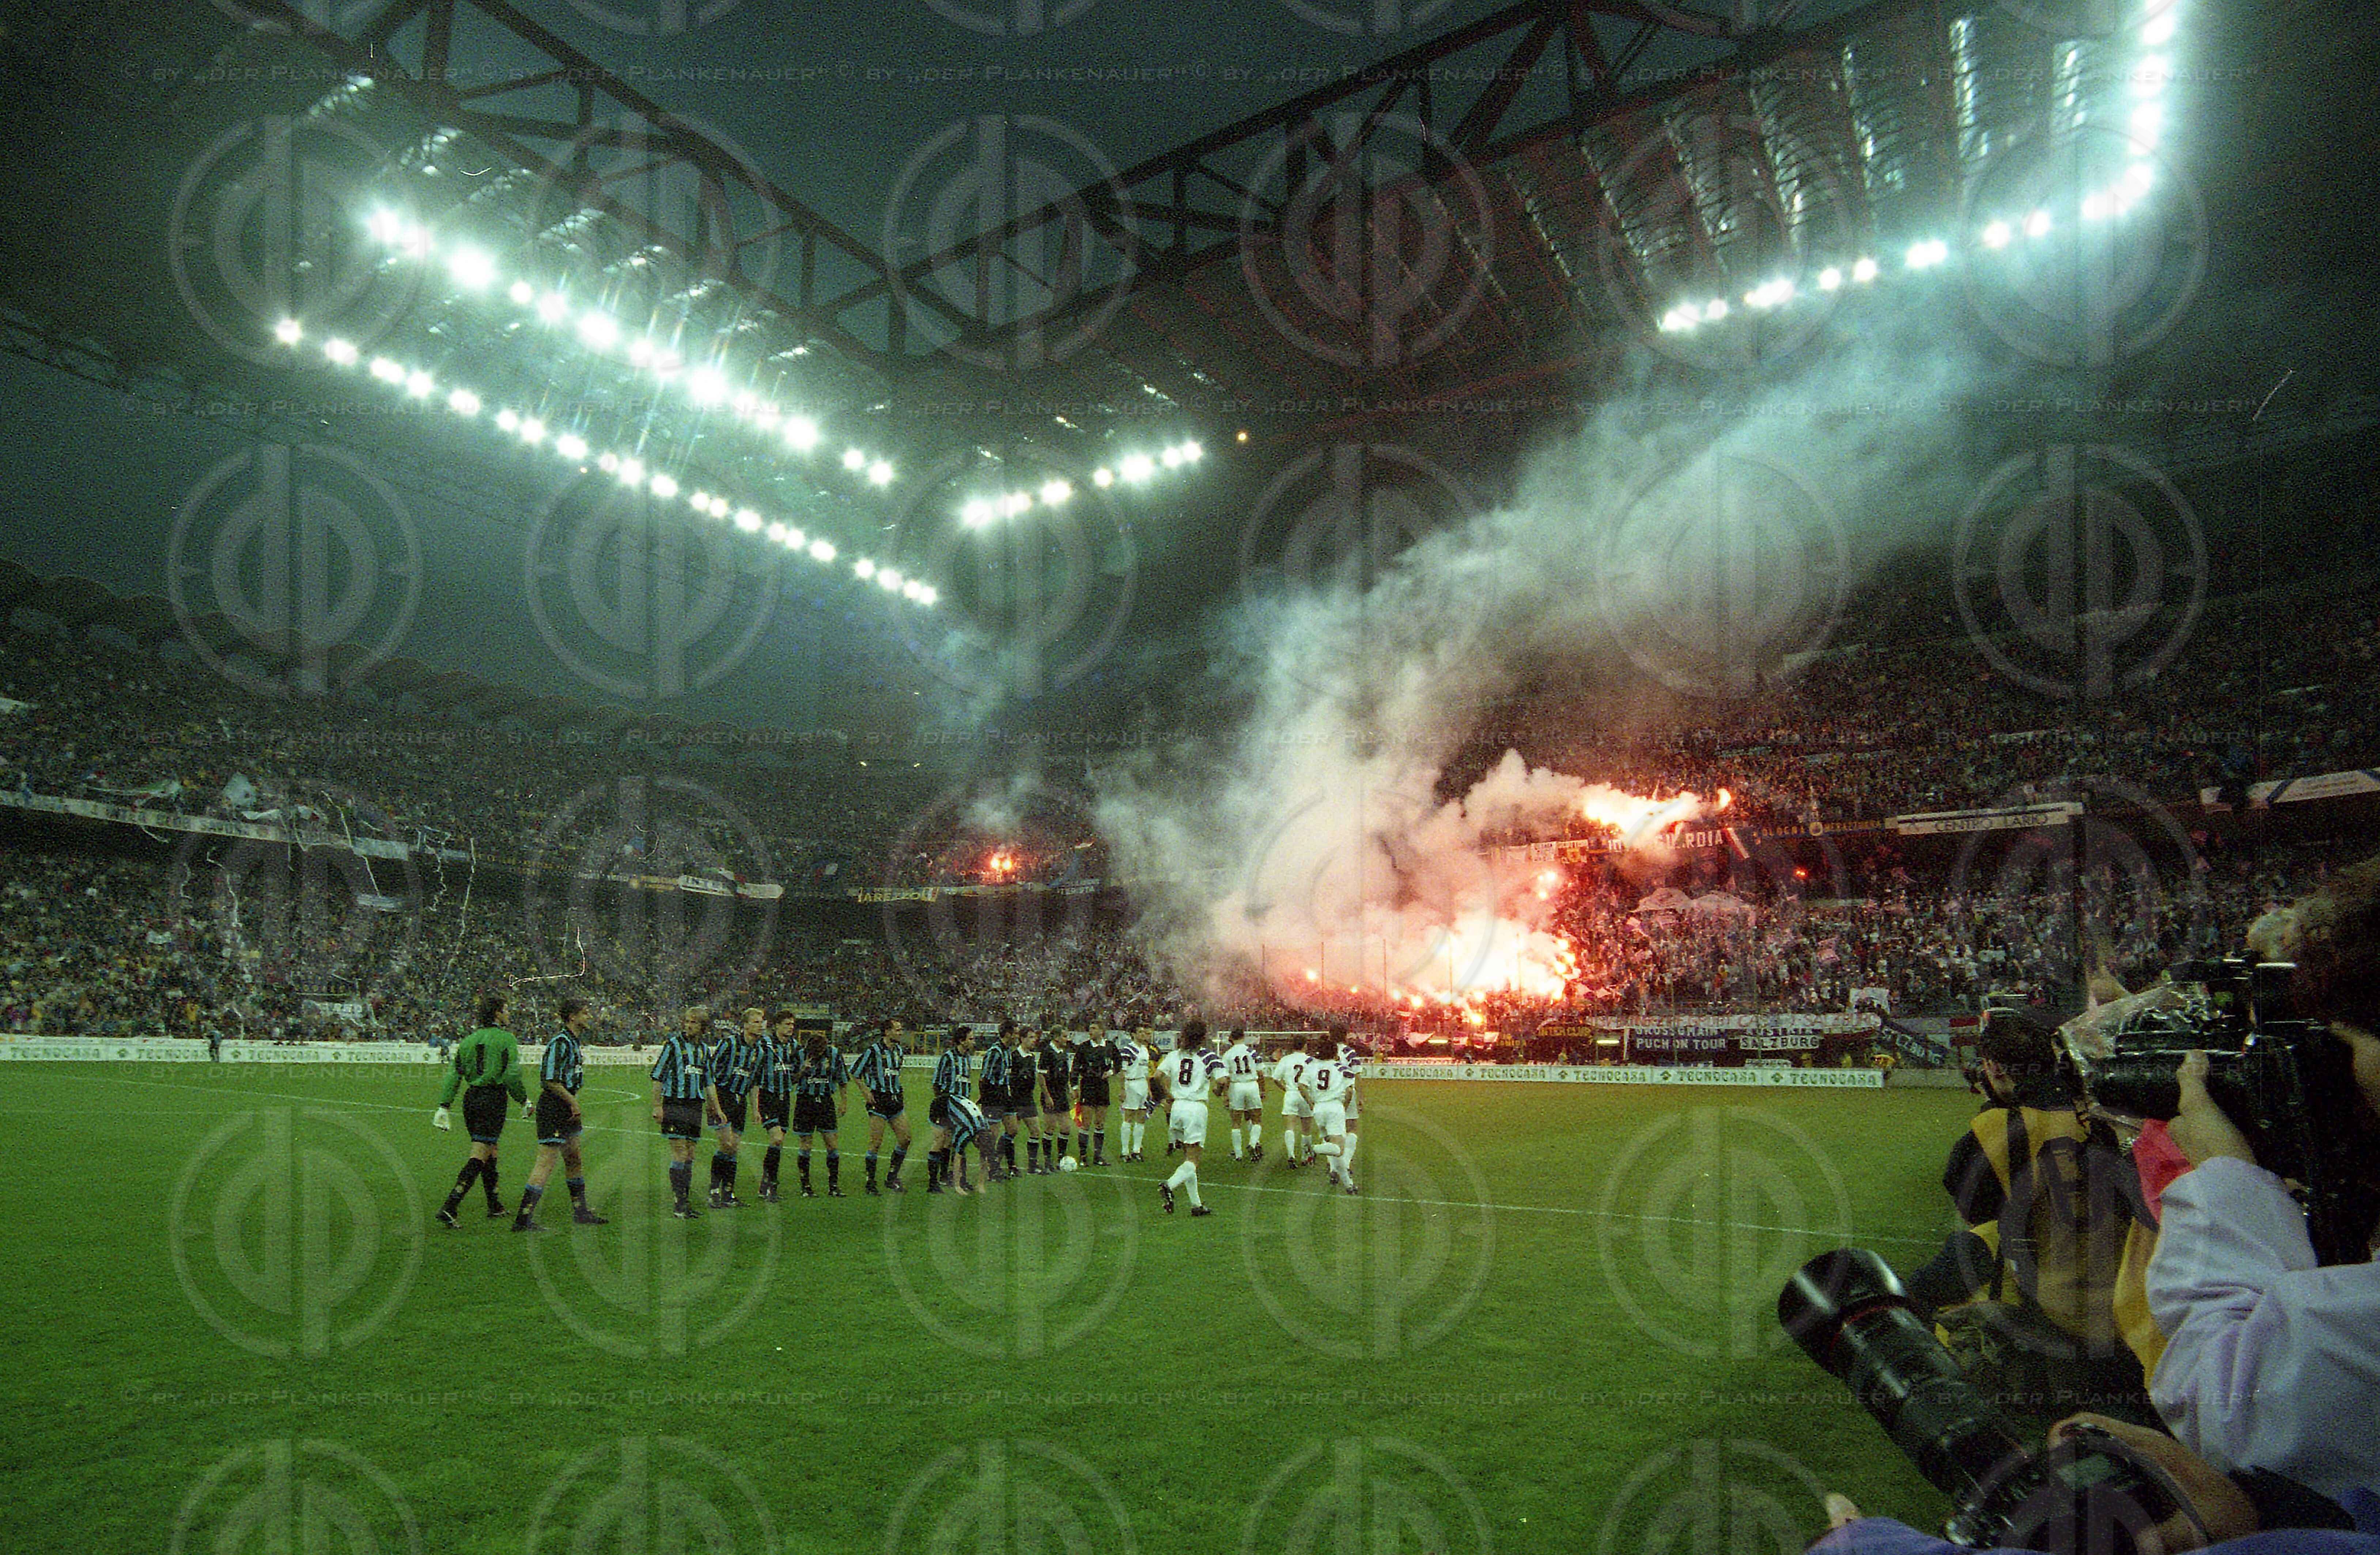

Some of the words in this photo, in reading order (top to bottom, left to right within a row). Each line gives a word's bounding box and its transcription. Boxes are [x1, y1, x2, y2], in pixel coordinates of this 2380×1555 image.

[1655, 830, 1722, 849] GURDIA
[1637, 1038, 1669, 1050] PUCH
[1694, 1038, 1726, 1050] TOUR
[1234, 1055, 1252, 1074] 11
[1178, 1058, 1194, 1085] 8
[1393, 1067, 1453, 1078] TECNOCASA
[1480, 1068, 1545, 1078] TECNOCASA
[1573, 1070, 1645, 1082] TECNOCASA
[1678, 1071, 1756, 1082] TECNOCASA
[1317, 1069, 1330, 1090] 9
[1791, 1073, 1876, 1085] TECNOCASA
